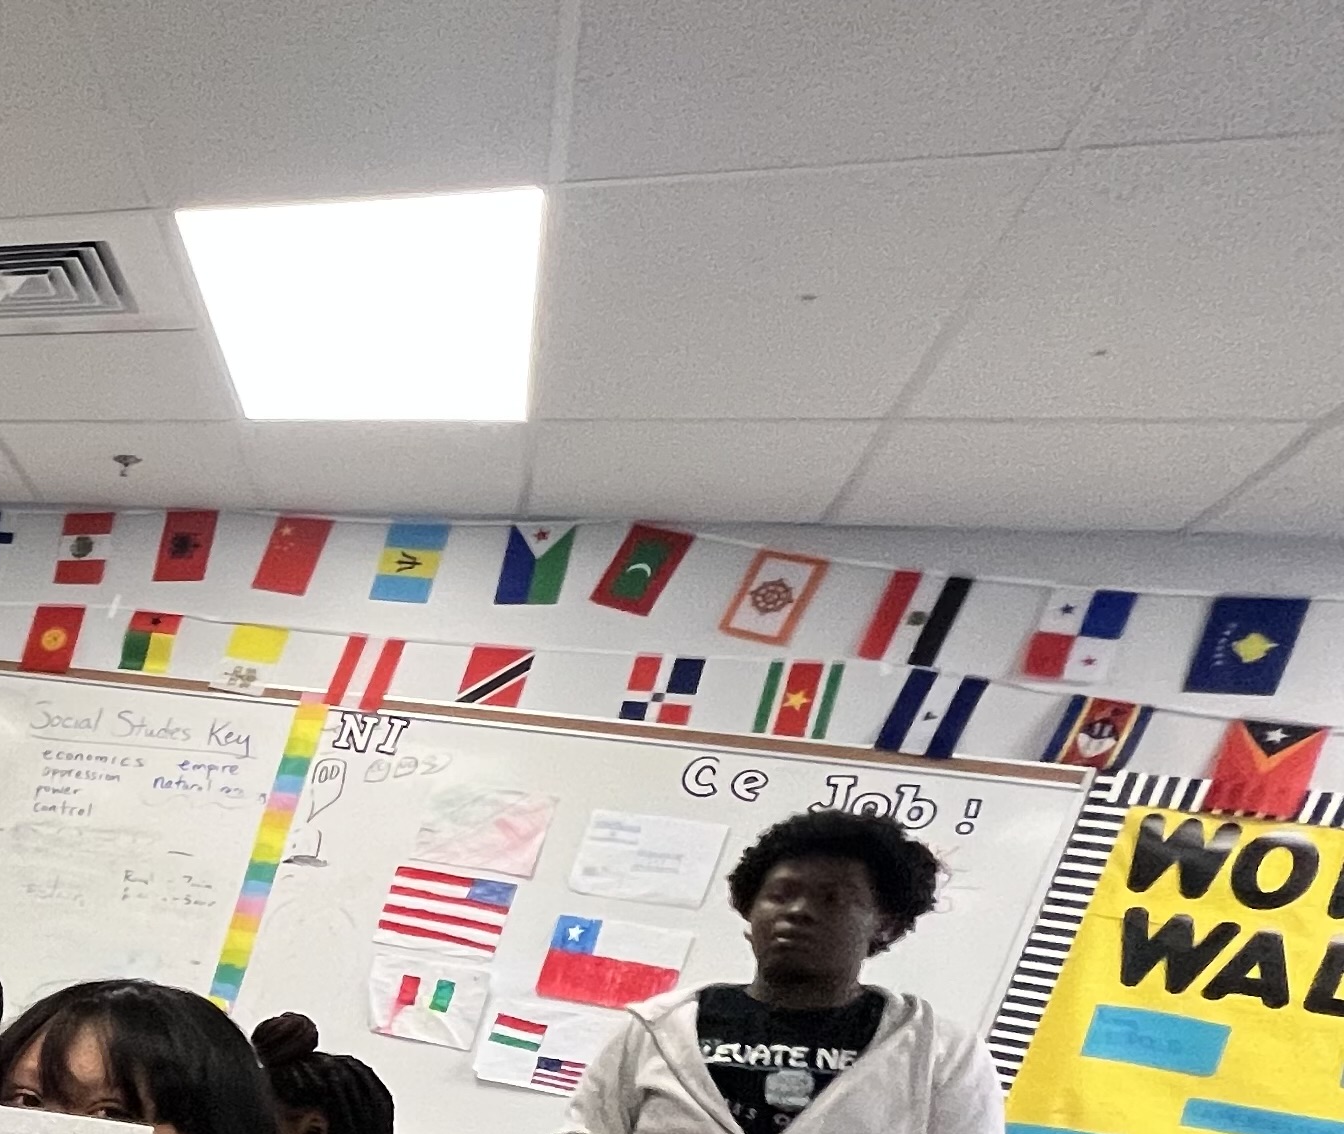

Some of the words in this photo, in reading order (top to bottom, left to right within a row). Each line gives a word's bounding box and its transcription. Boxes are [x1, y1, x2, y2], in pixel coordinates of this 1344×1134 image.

[29, 700, 103, 732] Social
[207, 720, 251, 759] Key
[42, 749, 145, 768] economics
[177, 759, 240, 780] empire
[42, 766, 121, 783] oppression
[35, 785, 81, 797] power
[33, 802, 93, 818] control
